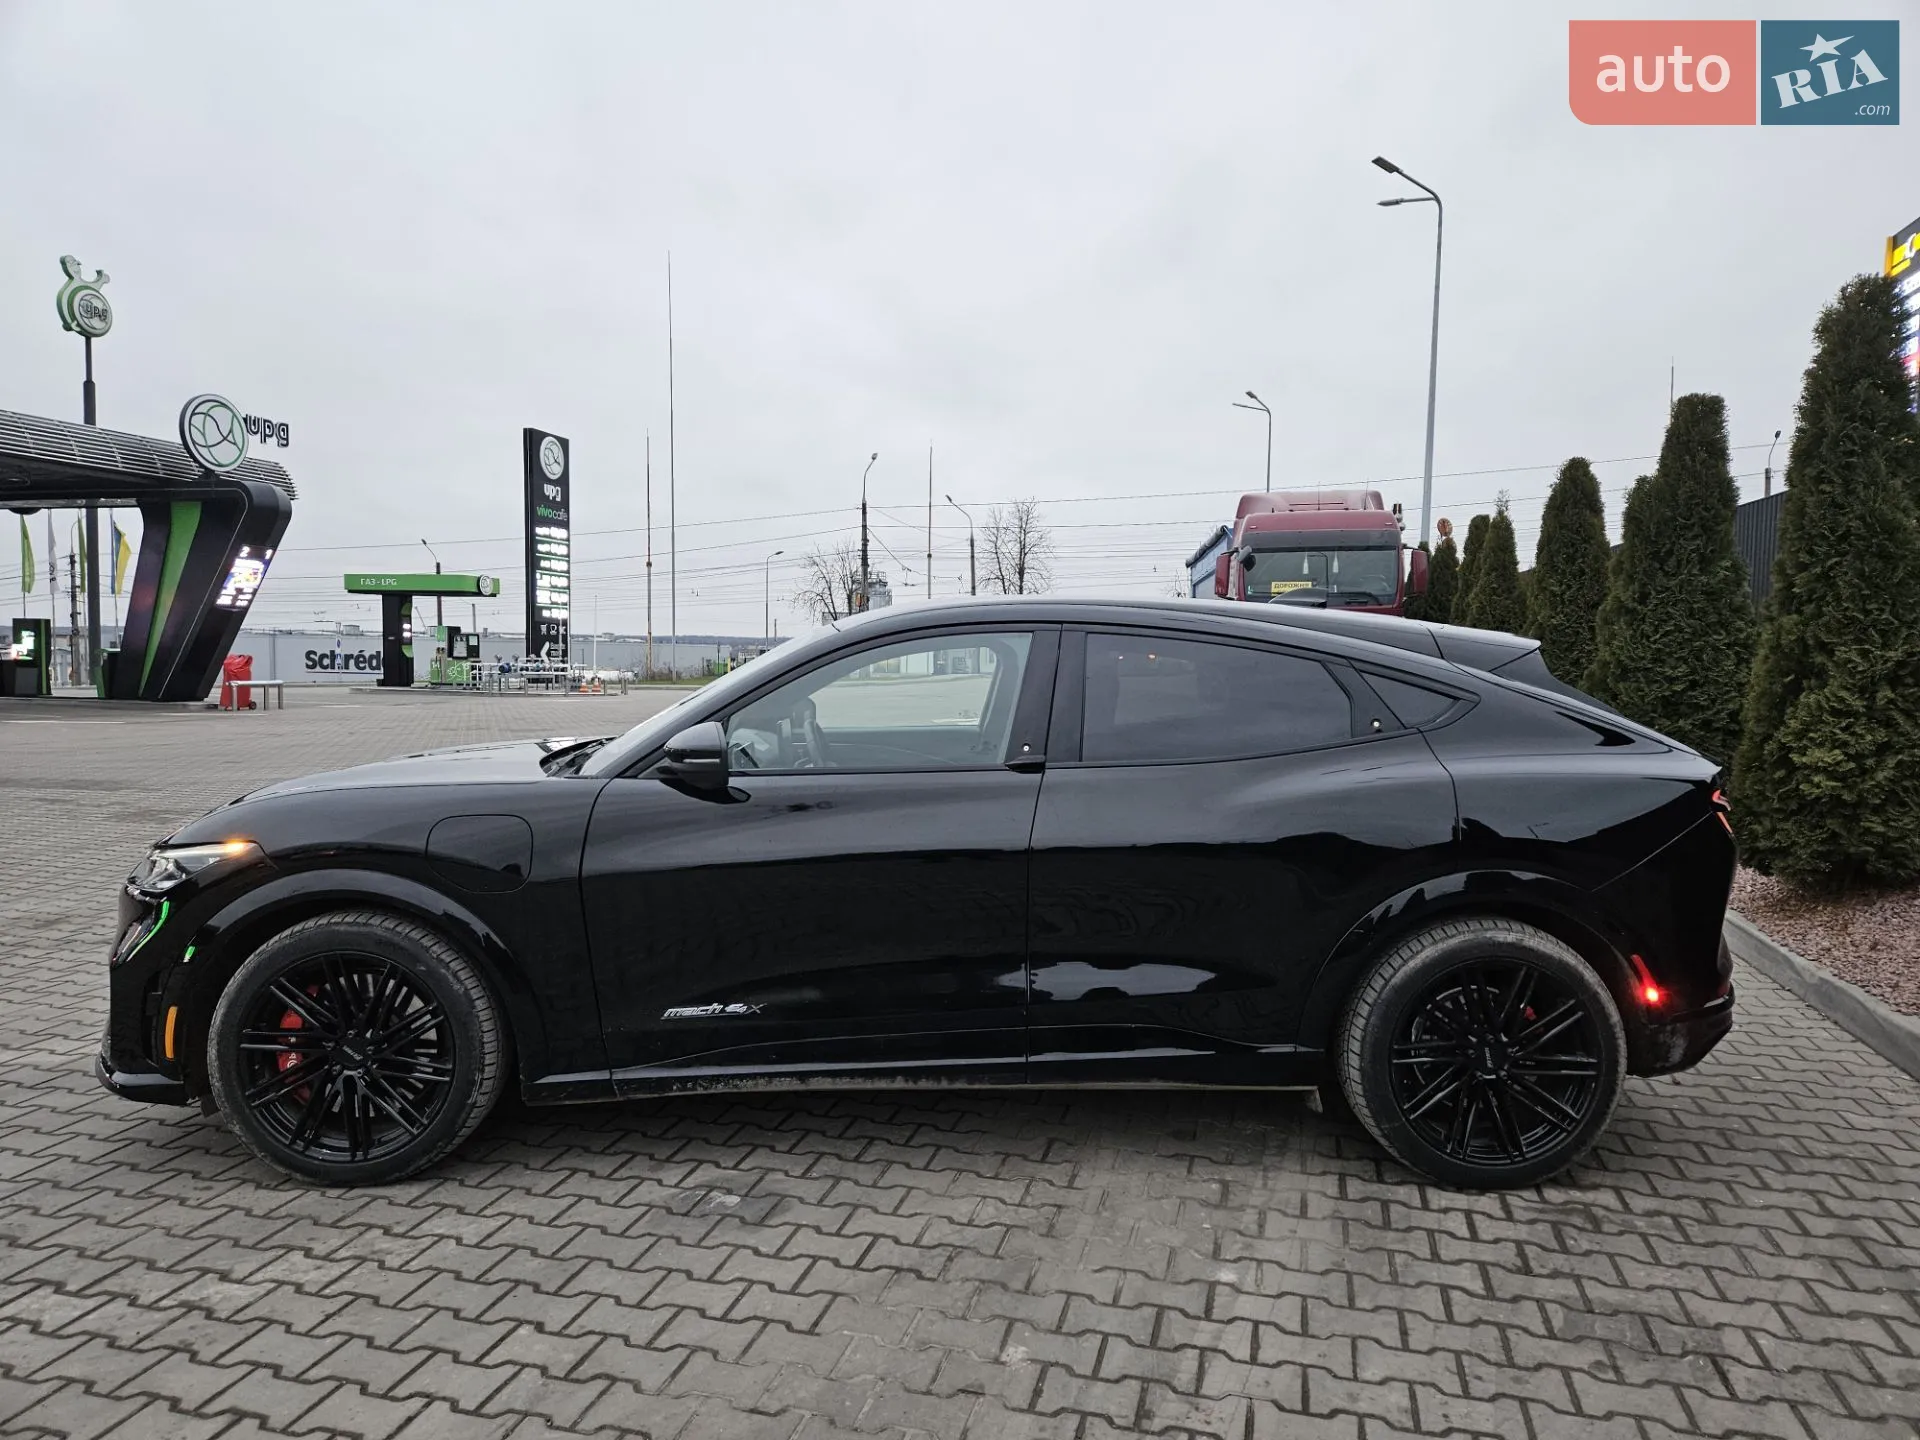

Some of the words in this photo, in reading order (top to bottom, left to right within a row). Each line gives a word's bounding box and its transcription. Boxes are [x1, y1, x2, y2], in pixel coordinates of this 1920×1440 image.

[83, 301, 108, 322] upg
[246, 414, 289, 447] upg
[543, 483, 561, 501] upg
[304, 649, 383, 671] Schréd
[663, 1003, 724, 1017] mach
